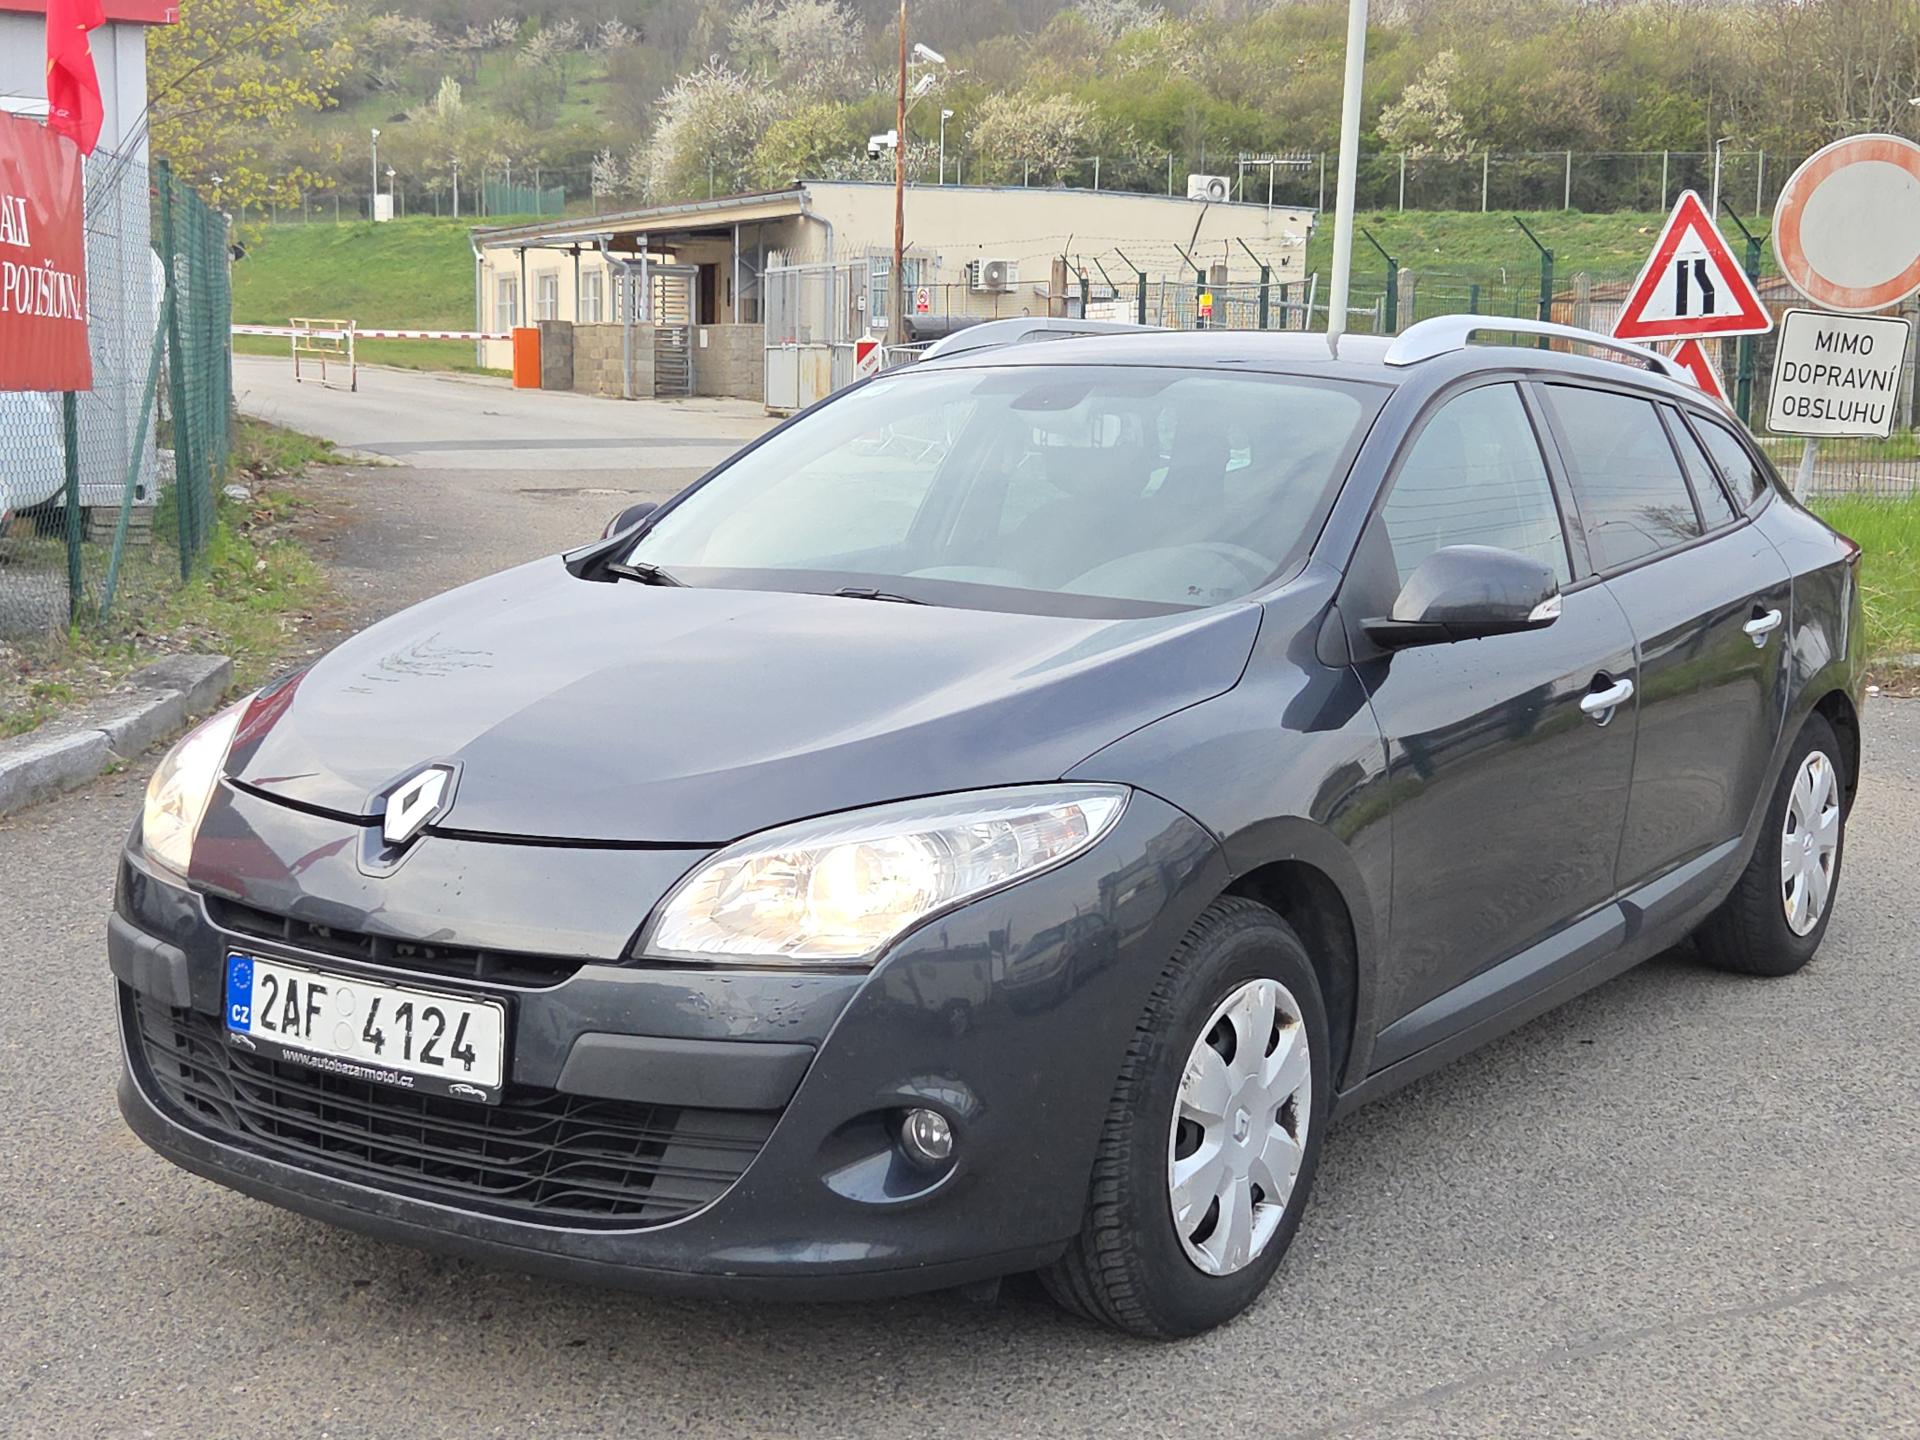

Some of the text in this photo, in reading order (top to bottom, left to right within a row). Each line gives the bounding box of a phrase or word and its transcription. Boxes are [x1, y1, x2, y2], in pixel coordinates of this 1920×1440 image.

[1815, 330, 1874, 355] MIMO
[1782, 361, 1897, 392] DOPRAVNÍ
[1782, 395, 1886, 424] OBSLUHU
[231, 1004, 250, 1024] CZ
[260, 973, 477, 1072] 2AF 4124
[282, 1048, 415, 1089] www.autobazarmotol.cz
